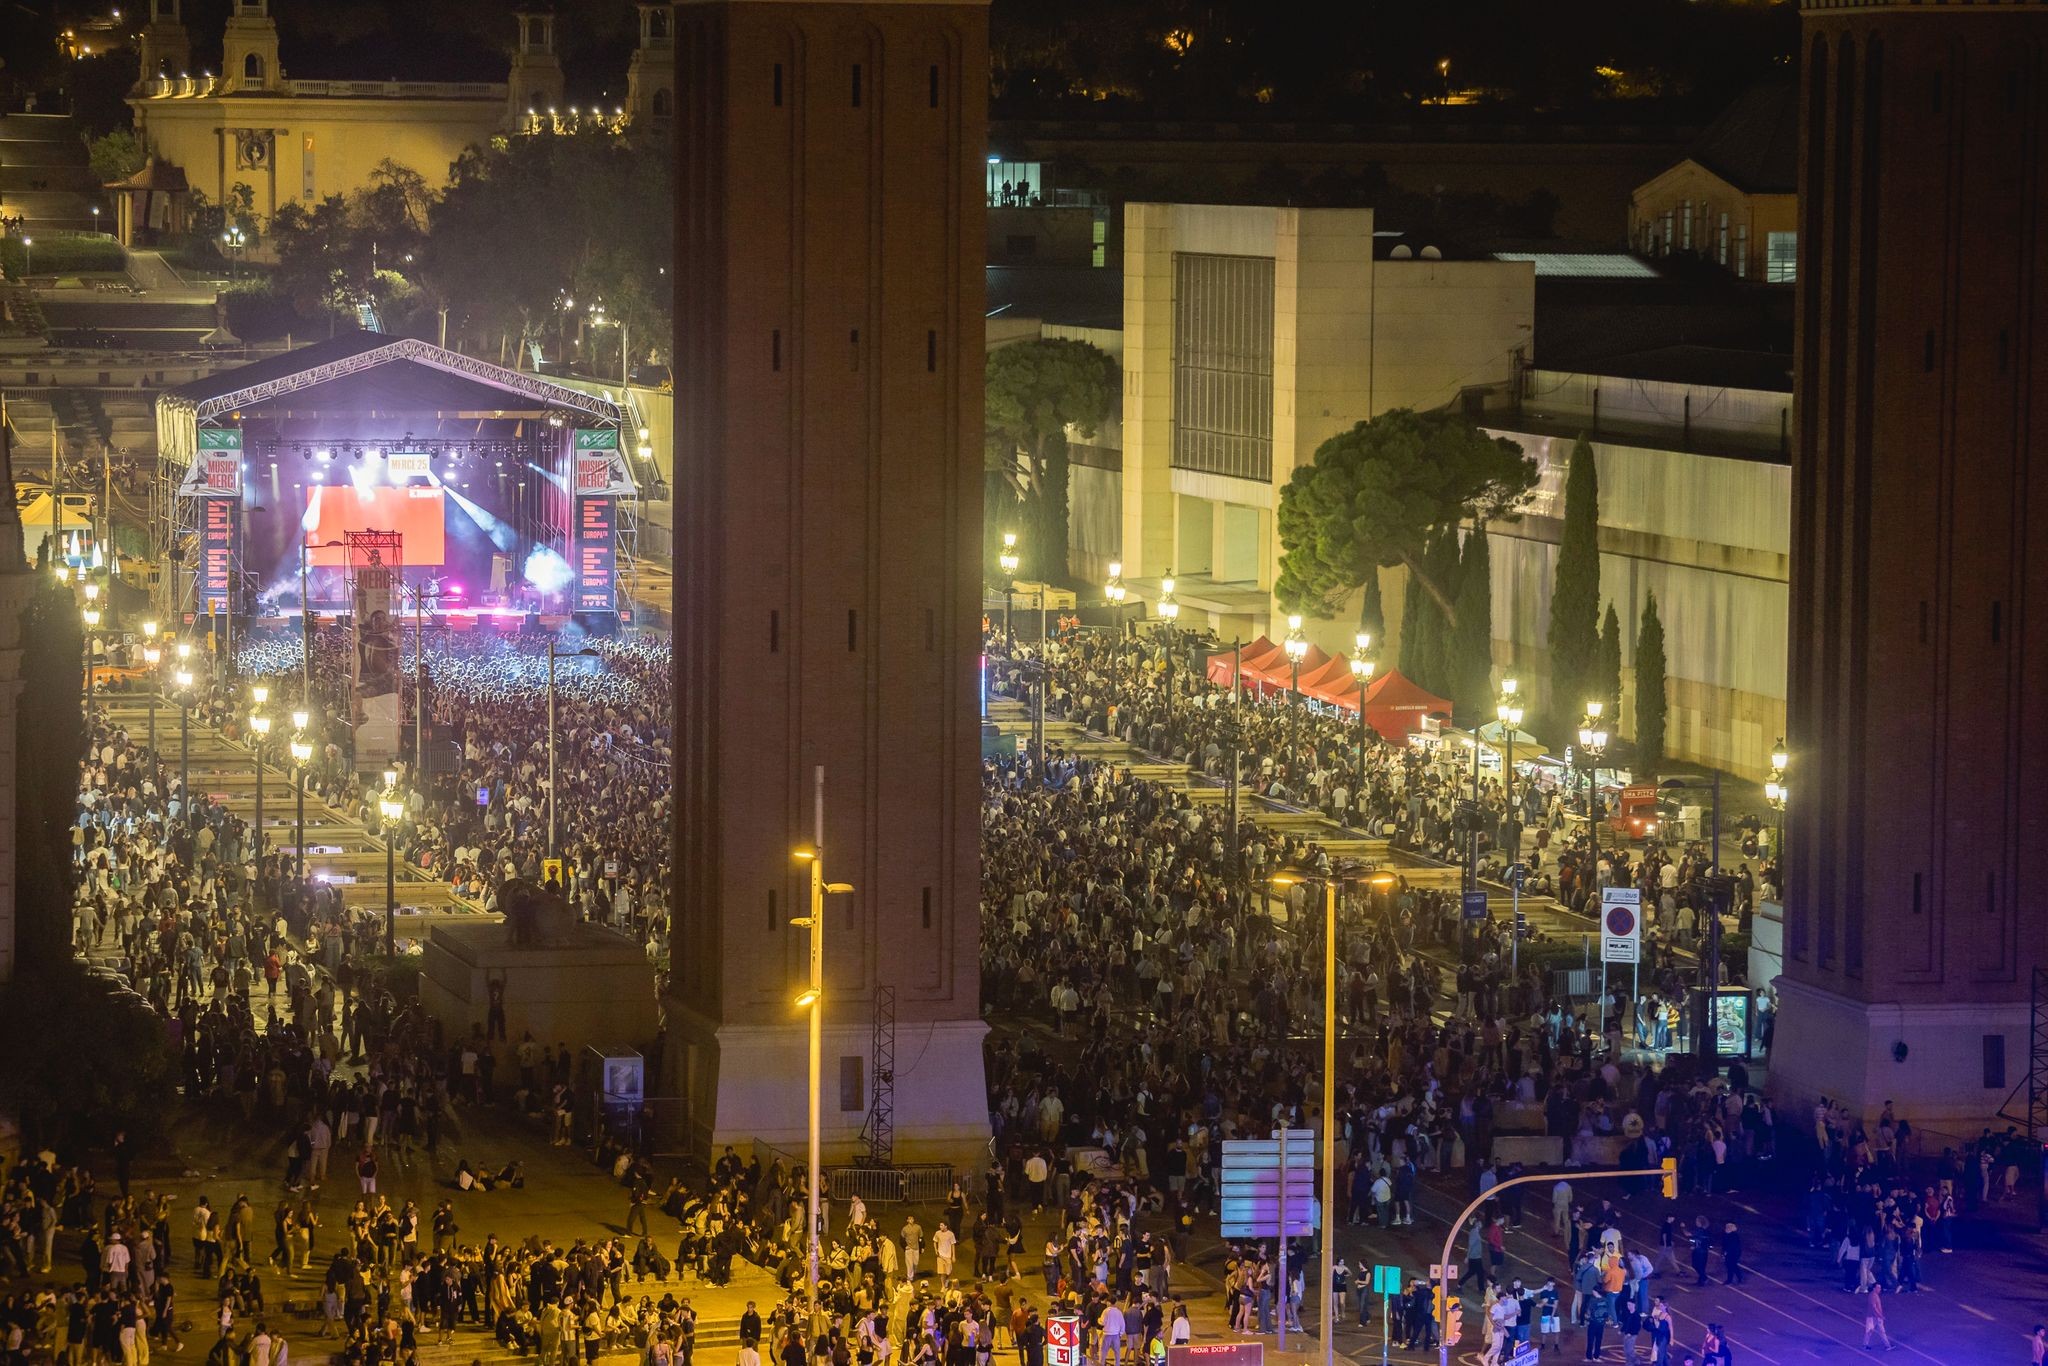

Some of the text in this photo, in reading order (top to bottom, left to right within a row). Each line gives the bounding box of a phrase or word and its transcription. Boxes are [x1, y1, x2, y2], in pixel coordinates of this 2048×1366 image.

[208, 474, 237, 488] MERC
[1053, 1327, 1061, 1336] M
[1057, 1350, 1068, 1362] L1
